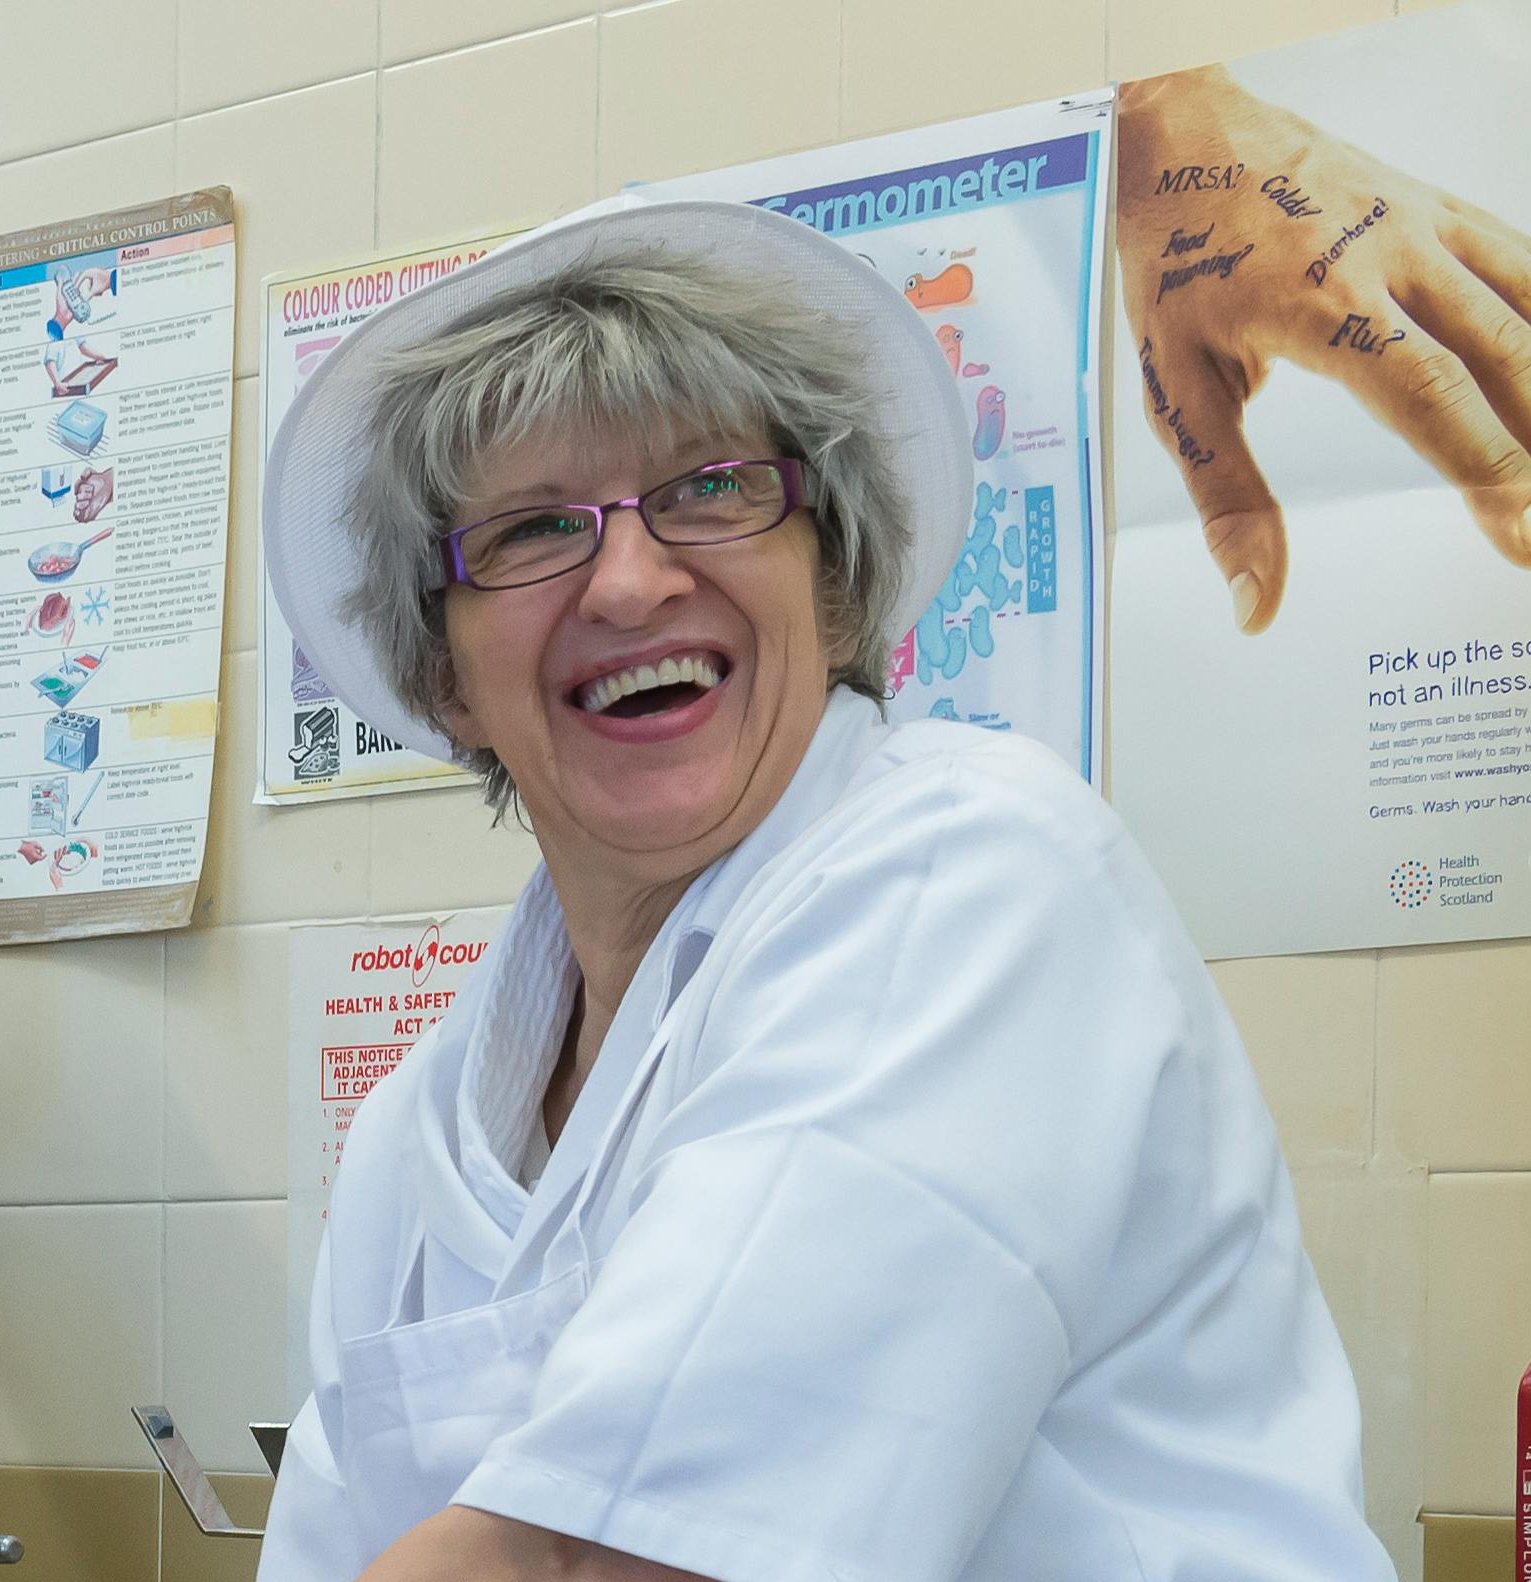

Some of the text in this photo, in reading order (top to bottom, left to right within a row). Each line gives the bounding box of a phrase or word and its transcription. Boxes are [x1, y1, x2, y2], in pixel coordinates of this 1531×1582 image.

[1154, 163, 1245, 196] MRSA?
[49, 234, 107, 257] CRITICAL
[110, 221, 168, 246] CONTROL
[172, 208, 216, 229] POINTS
[1161, 222, 1215, 257] Food
[121, 247, 149, 261] Action
[1156, 243, 1254, 304] poisoning?
[284, 281, 340, 323] COLOUR
[345, 271, 393, 311] CODED
[284, 320, 313, 337] eliminate
[315, 319, 325, 330] the
[326, 316, 338, 328] risk
[341, 314, 348, 326] of
[1328, 313, 1406, 356] Flu?
[1140, 336, 1215, 469] Tummy bugs?
[1028, 510, 1039, 592] RAPID
[1040, 500, 1052, 599] GROWTH
[1369, 640, 1503, 674] Pick up the
[1369, 684, 1406, 707] not
[1414, 684, 1443, 704] an
[1369, 707, 1528, 733] Many germs can be spread by
[1369, 725, 1522, 751] Just wash your hands regularly
[1369, 757, 1389, 769] and
[1426, 752, 1453, 763] more
[1456, 748, 1482, 761] likely
[1486, 747, 1496, 757] to
[1499, 746, 1521, 757] stay
[1369, 774, 1427, 787] information
[1430, 770, 1451, 781] visit
[1369, 805, 1417, 819] Germs.
[1423, 798, 1459, 814] Wash
[1465, 798, 1496, 812] your
[1440, 854, 1479, 870] Health
[1439, 872, 1502, 888] Protection
[1440, 890, 1493, 907] Scotland
[351, 942, 489, 972] robot cou
[326, 992, 456, 1016] HEALTH & SAFET
[393, 1018, 423, 1035] ACT
[327, 1048, 403, 1065] THIS NOTICE
[337, 1082, 348, 1095] IT
